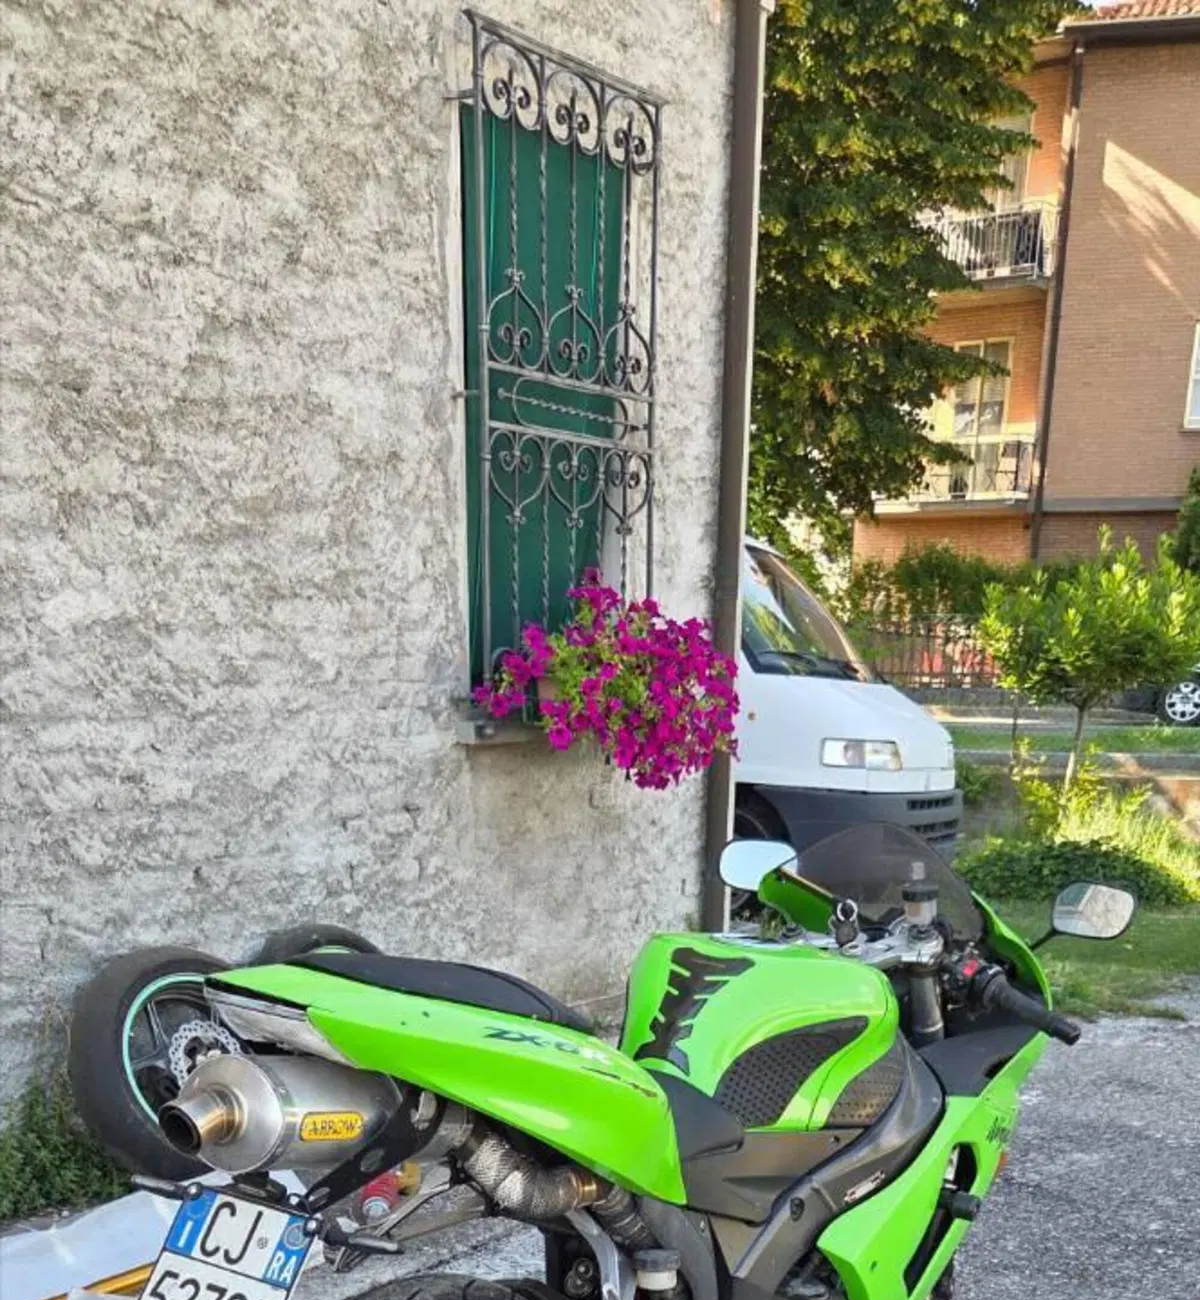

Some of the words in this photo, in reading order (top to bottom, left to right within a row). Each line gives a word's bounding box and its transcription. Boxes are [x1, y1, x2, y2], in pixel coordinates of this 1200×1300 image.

[307, 1116, 359, 1136] ARROW
[200, 1202, 263, 1265] CJ
[267, 1249, 297, 1284] RA
